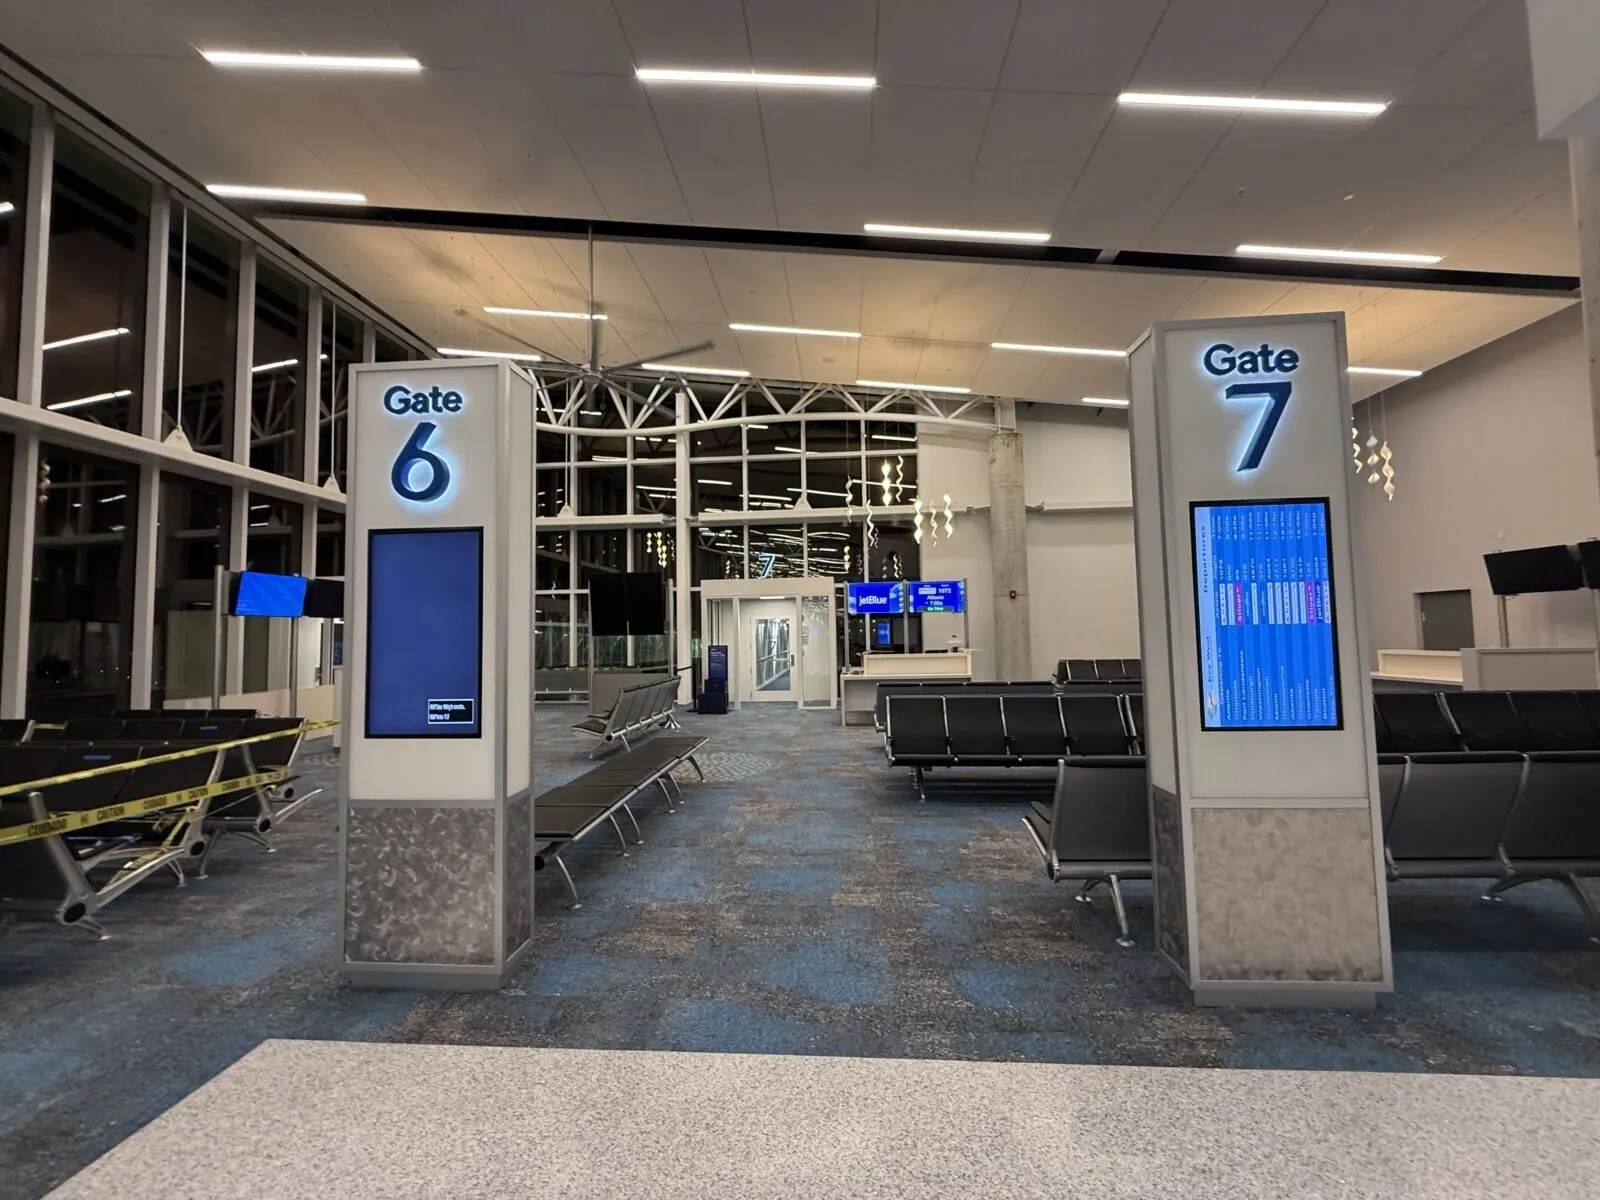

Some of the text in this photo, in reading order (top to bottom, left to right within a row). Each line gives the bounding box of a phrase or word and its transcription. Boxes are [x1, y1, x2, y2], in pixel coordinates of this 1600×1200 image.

[1203, 343, 1299, 376] Gate
[384, 385, 463, 415] Gate
[1225, 381, 1292, 472] 7
[391, 421, 450, 503] 6
[758, 554, 775, 578] 7
[1200, 524, 1209, 592] Departures
[858, 595, 888, 606] jetBlue
[97, 805, 125, 821] CAUTION
